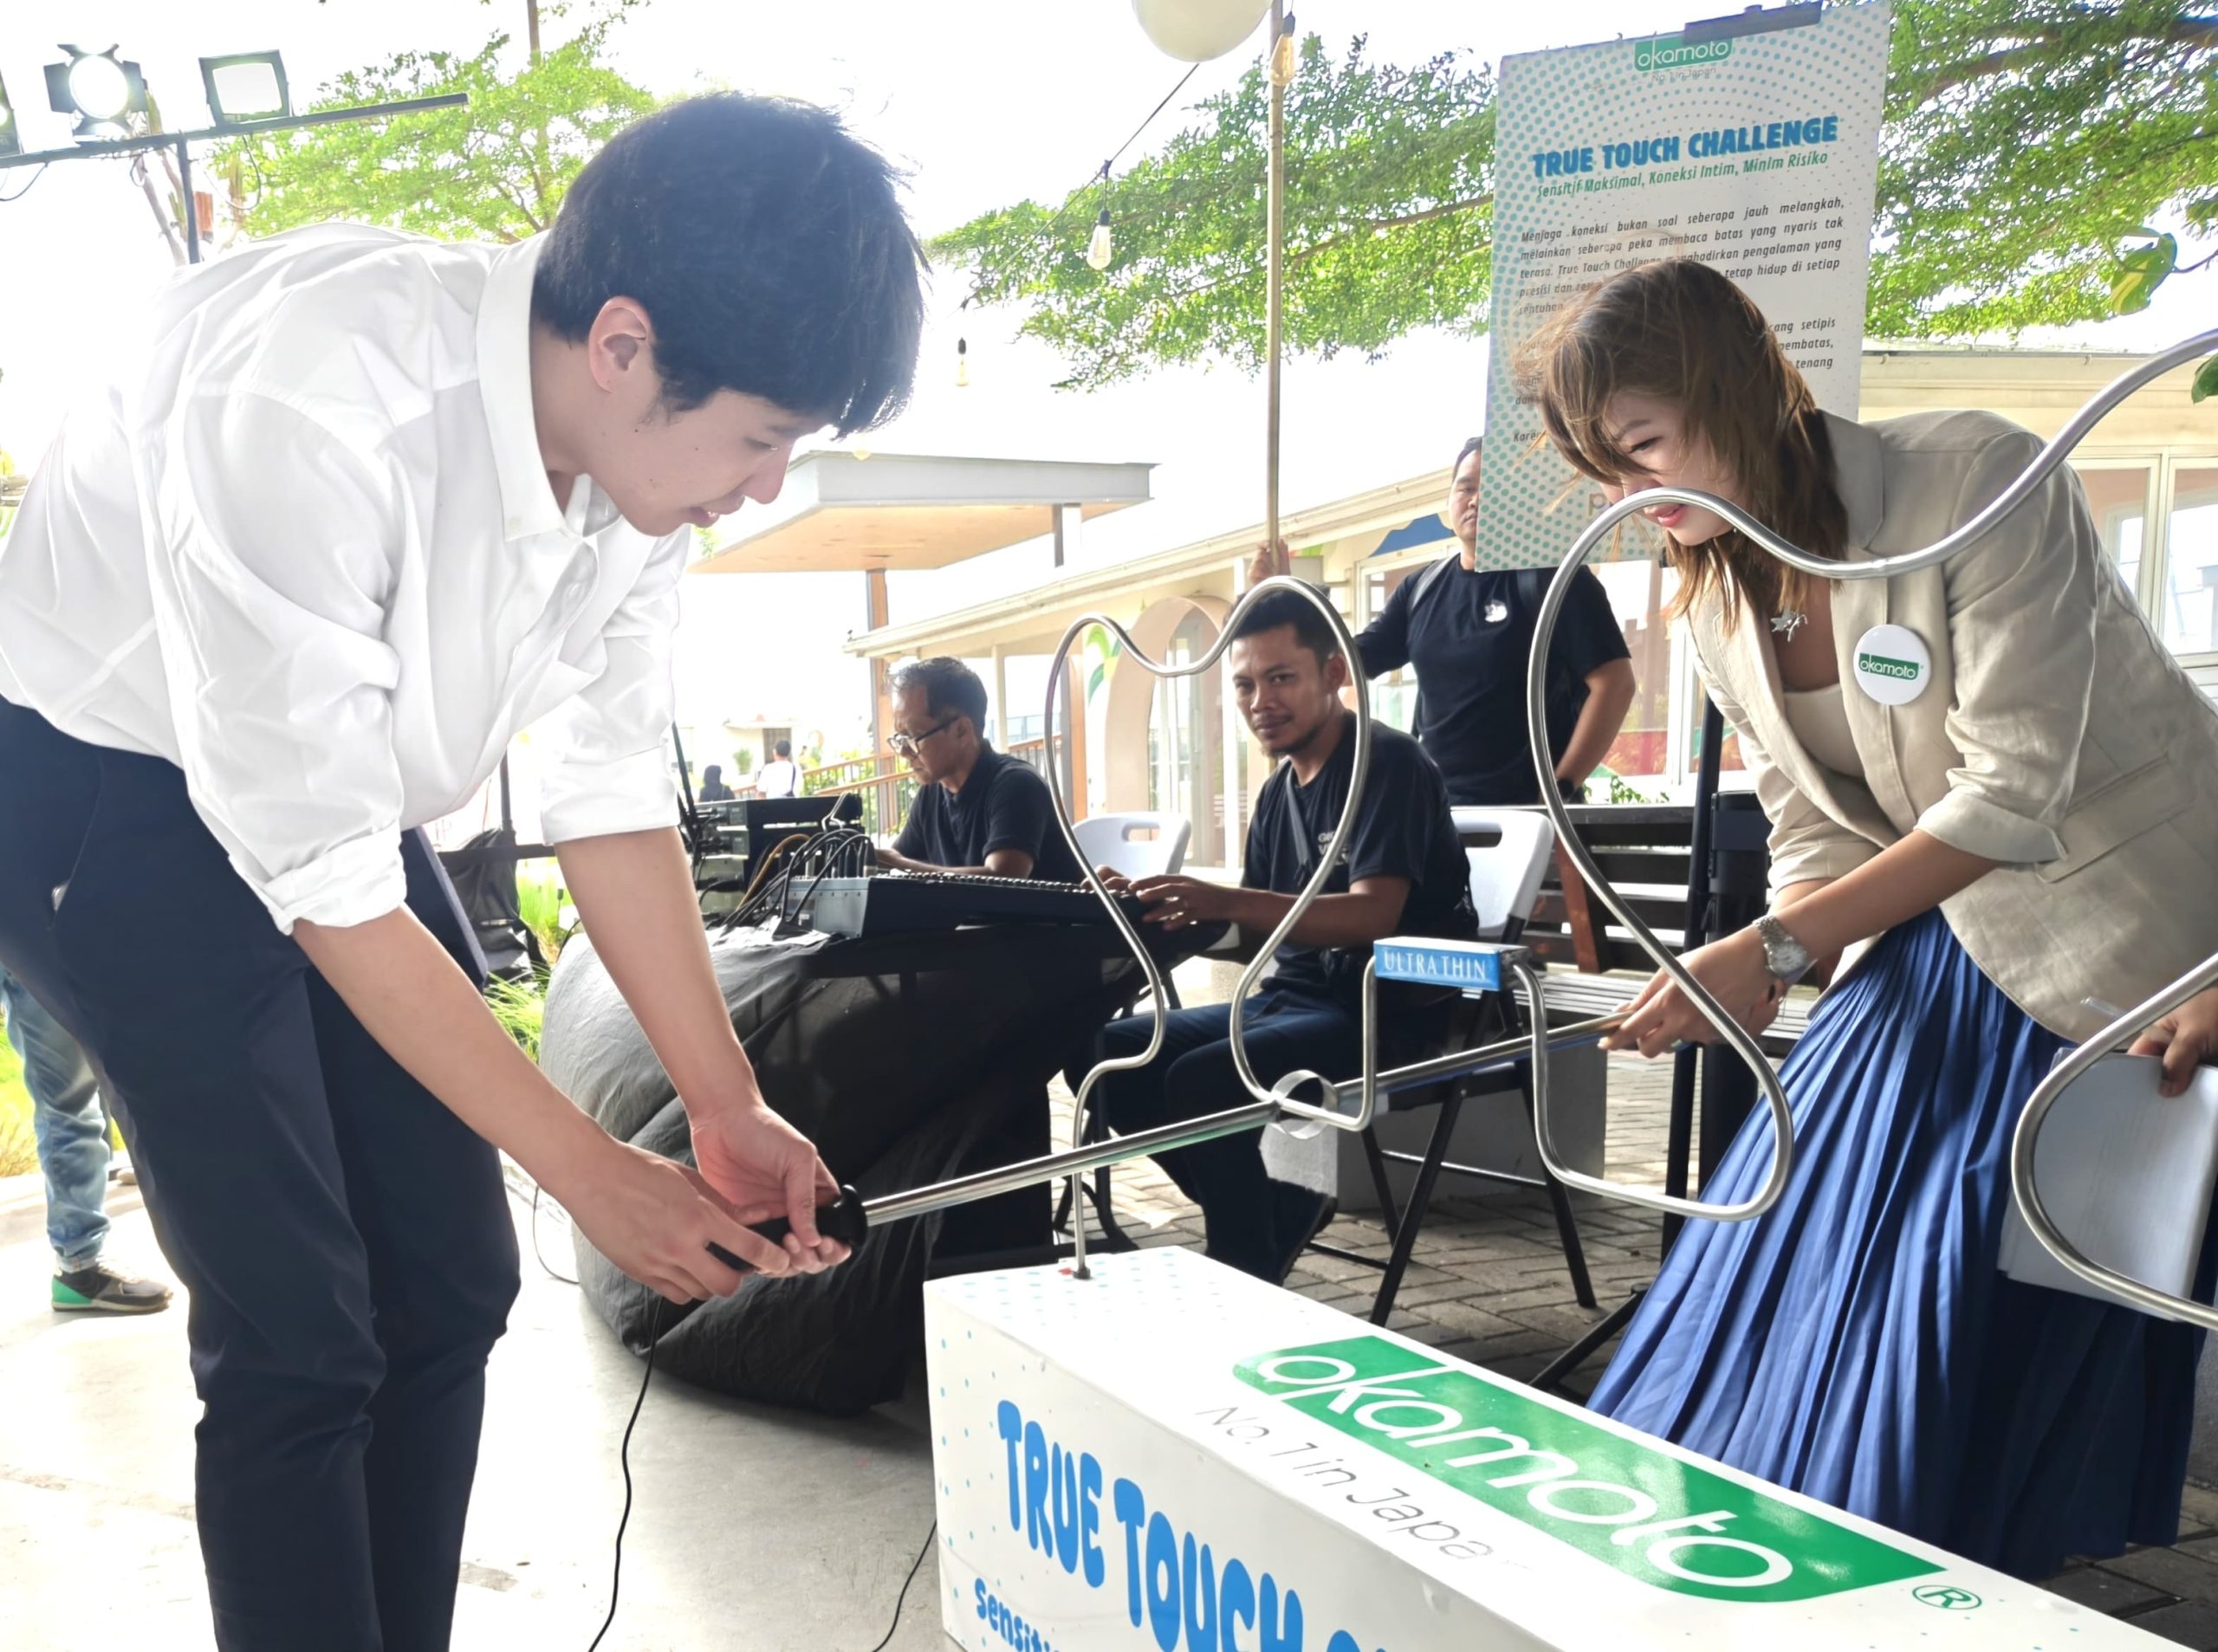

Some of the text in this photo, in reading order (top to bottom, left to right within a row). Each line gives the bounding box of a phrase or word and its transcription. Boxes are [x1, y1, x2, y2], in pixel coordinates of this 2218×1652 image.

[1638, 41, 1728, 69] okamoto
[1533, 115, 1839, 178] TRUE TOUCH CHALLENGE
[1537, 151, 1828, 198] Sensitif Maksimal, Koneksi Intim, Minim Risiko
[1521, 197, 1845, 243] Menjaga koneksi bukan soal seberapa jauh melangkah,
[1521, 217, 1843, 260] melainkan seberapa peka membaca batas yang nyaris tak
[1520, 268, 1553, 279] terasa.
[1559, 265, 1579, 276] True
[1583, 260, 1610, 273] Touch
[1742, 242, 1810, 260] pengalaman
[1815, 239, 1842, 253] yang
[1554, 283, 1572, 293] dan
[1725, 266, 1753, 280] tetap
[1757, 262, 1787, 275] hidup
[1792, 261, 1803, 272] di
[1806, 259, 1840, 272] setiap
[1801, 317, 1836, 331] setipis
[1795, 358, 1833, 370] tenang
[1859, 655, 1916, 679] okamoto
[1384, 950, 1488, 981] ULTRA THIN
[1195, 1405, 1534, 1571] No. 1 in Japa
[1256, 1356, 1793, 1588] okamoto
[997, 1400, 1303, 1652] TRUE TOUCH
